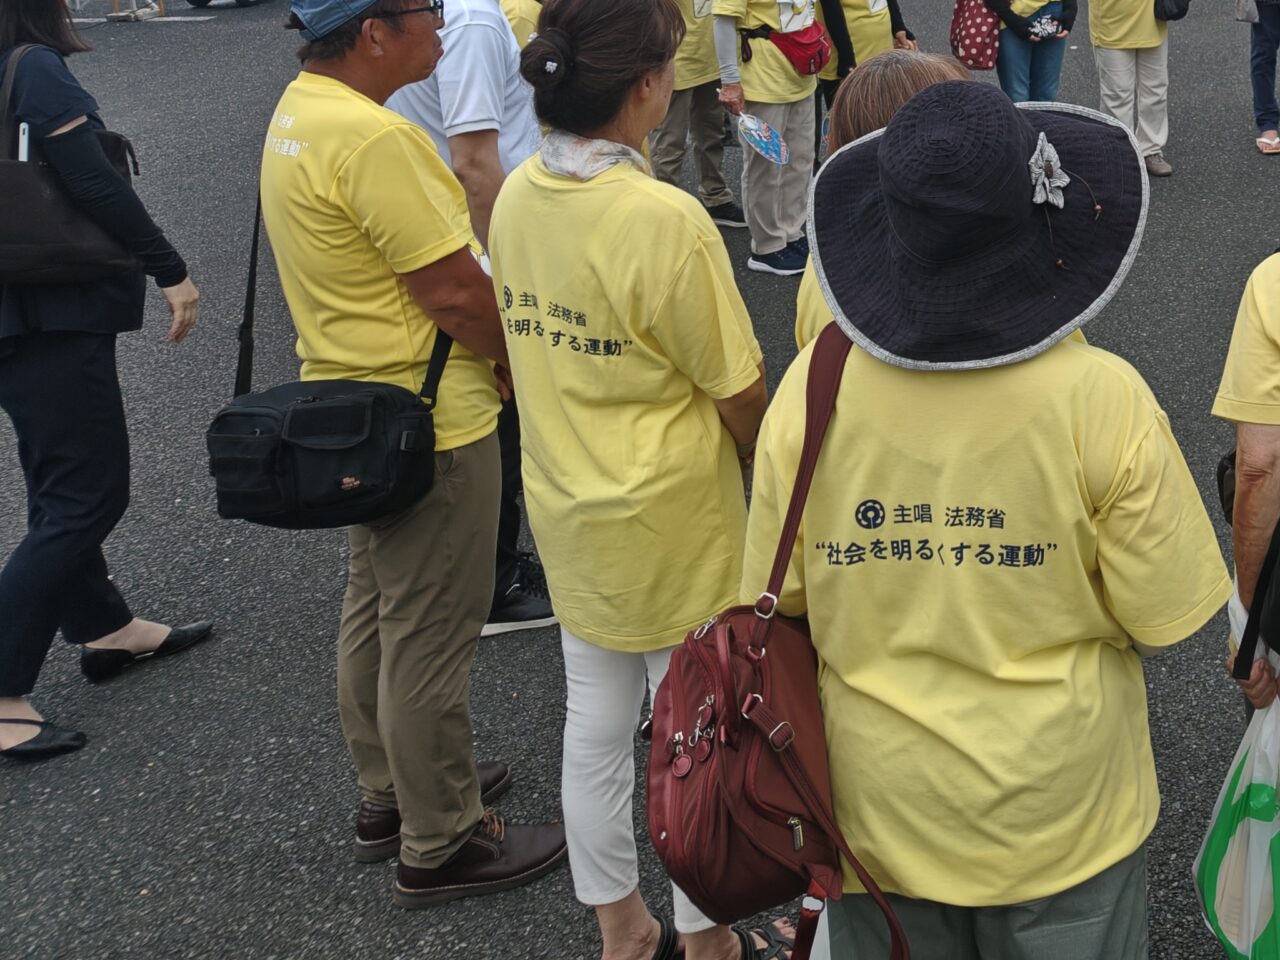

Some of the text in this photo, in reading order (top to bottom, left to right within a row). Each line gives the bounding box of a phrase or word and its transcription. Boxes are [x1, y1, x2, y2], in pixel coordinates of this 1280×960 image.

[546, 301, 587, 327] 法務省
[893, 503, 1007, 529] 主唱 法務省
